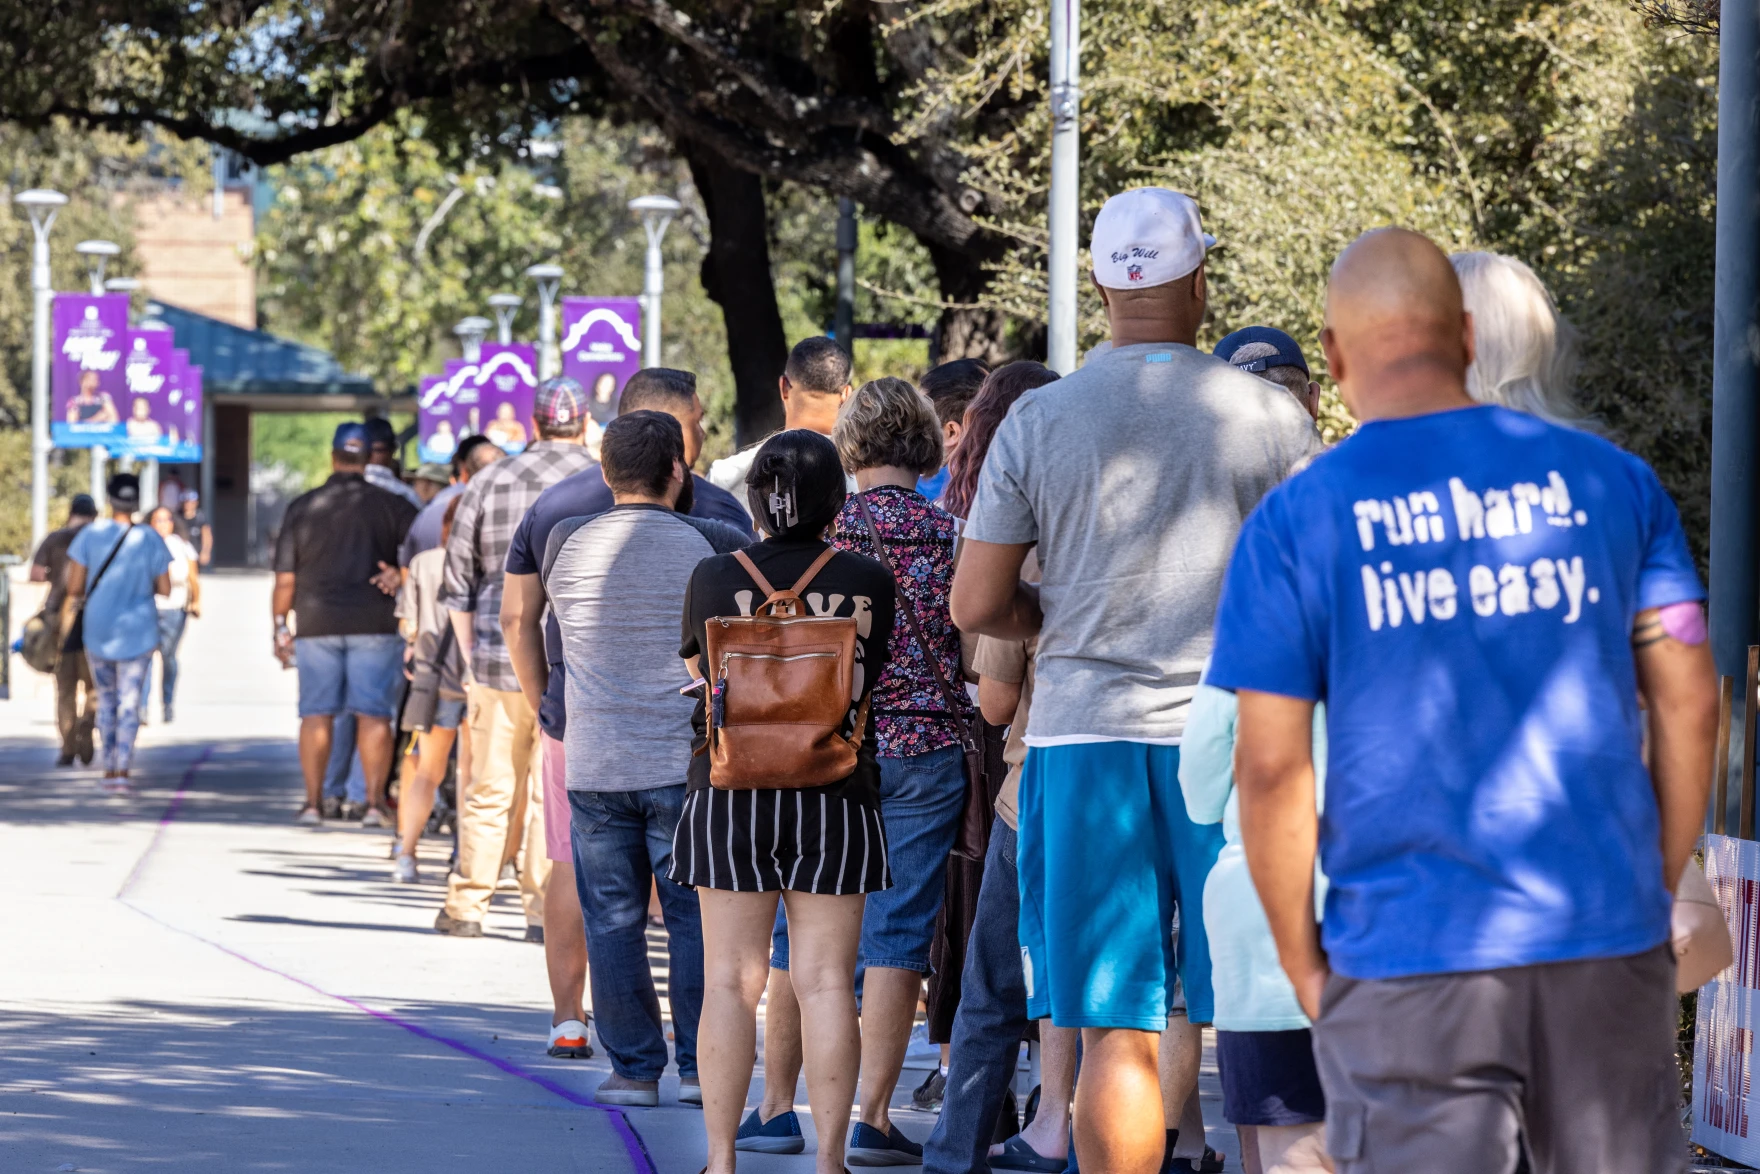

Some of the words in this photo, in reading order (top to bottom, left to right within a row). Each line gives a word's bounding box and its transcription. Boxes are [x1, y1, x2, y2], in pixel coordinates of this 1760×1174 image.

[1111, 251, 1129, 263] Big
[1132, 247, 1159, 260] Will
[1146, 353, 1172, 364] PUMA
[1353, 491, 1445, 551] run
[1449, 470, 1588, 541] hard.
[1361, 560, 1458, 631] live
[1469, 556, 1600, 624] easy.
